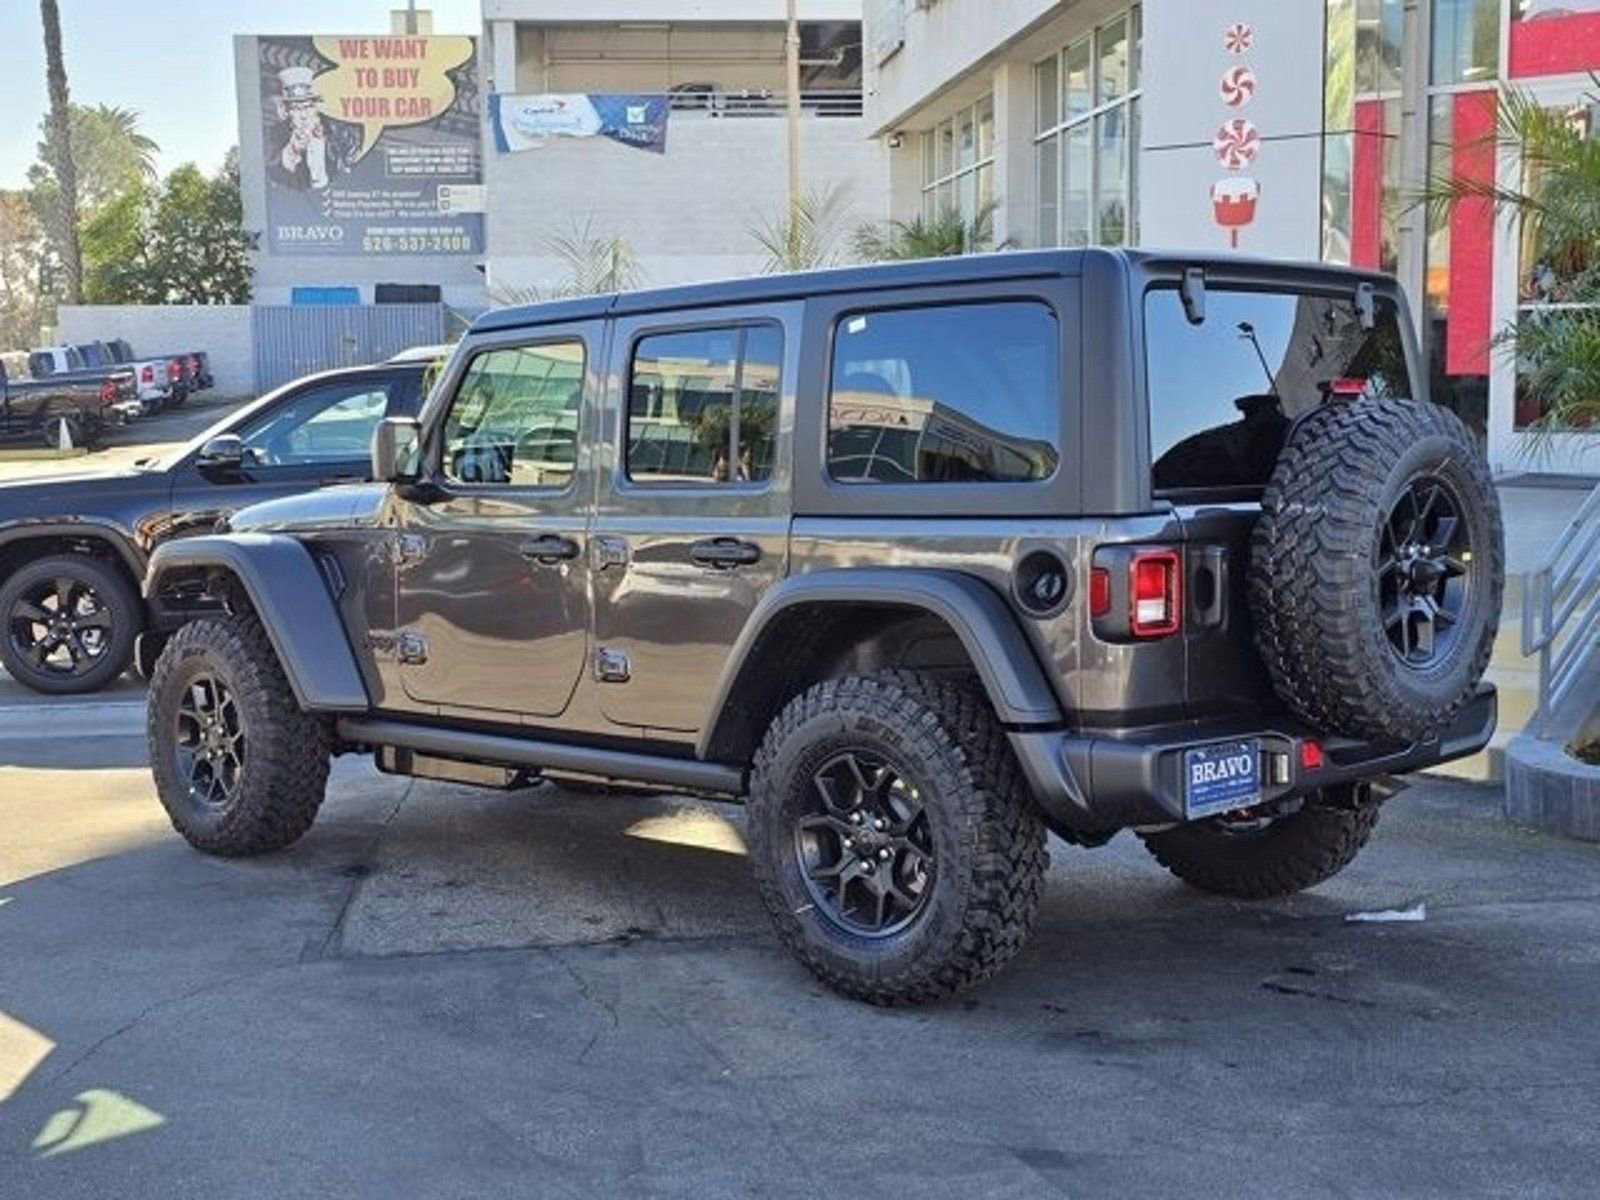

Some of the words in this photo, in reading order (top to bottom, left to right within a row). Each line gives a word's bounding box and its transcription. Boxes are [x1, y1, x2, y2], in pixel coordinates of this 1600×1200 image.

[339, 39, 370, 59] WE
[373, 39, 428, 59] WANT
[355, 67, 378, 88] TO
[384, 67, 420, 88] BUY
[340, 97, 391, 117] YOUR
[395, 97, 432, 117] CAR
[279, 225, 344, 241] BRAVO
[1191, 754, 1252, 785] BRAVO
